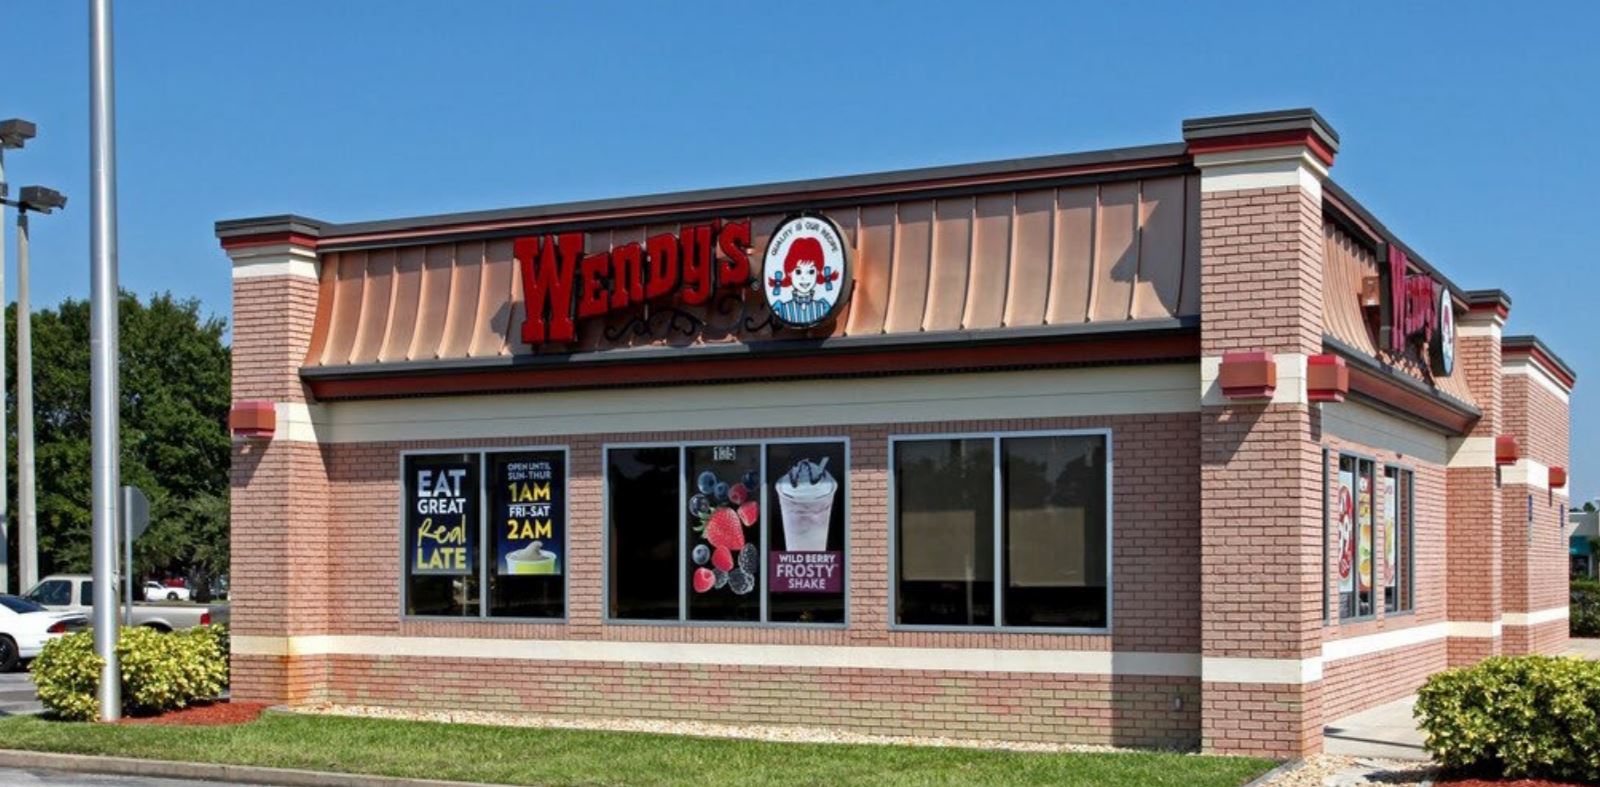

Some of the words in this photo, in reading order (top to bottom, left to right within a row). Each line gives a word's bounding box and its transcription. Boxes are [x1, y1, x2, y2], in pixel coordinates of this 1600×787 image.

[507, 462, 528, 471] OPEN
[528, 461, 552, 471] UNTIL
[417, 469, 466, 498] EAT
[417, 498, 466, 514] GREAT
[509, 505, 551, 518] FRI-SAT
[417, 514, 466, 547] Real
[416, 547, 466, 570] LATE
[779, 554, 804, 563] WILD
[805, 554, 836, 563] BERRY
[788, 578, 826, 589] SHAKE
